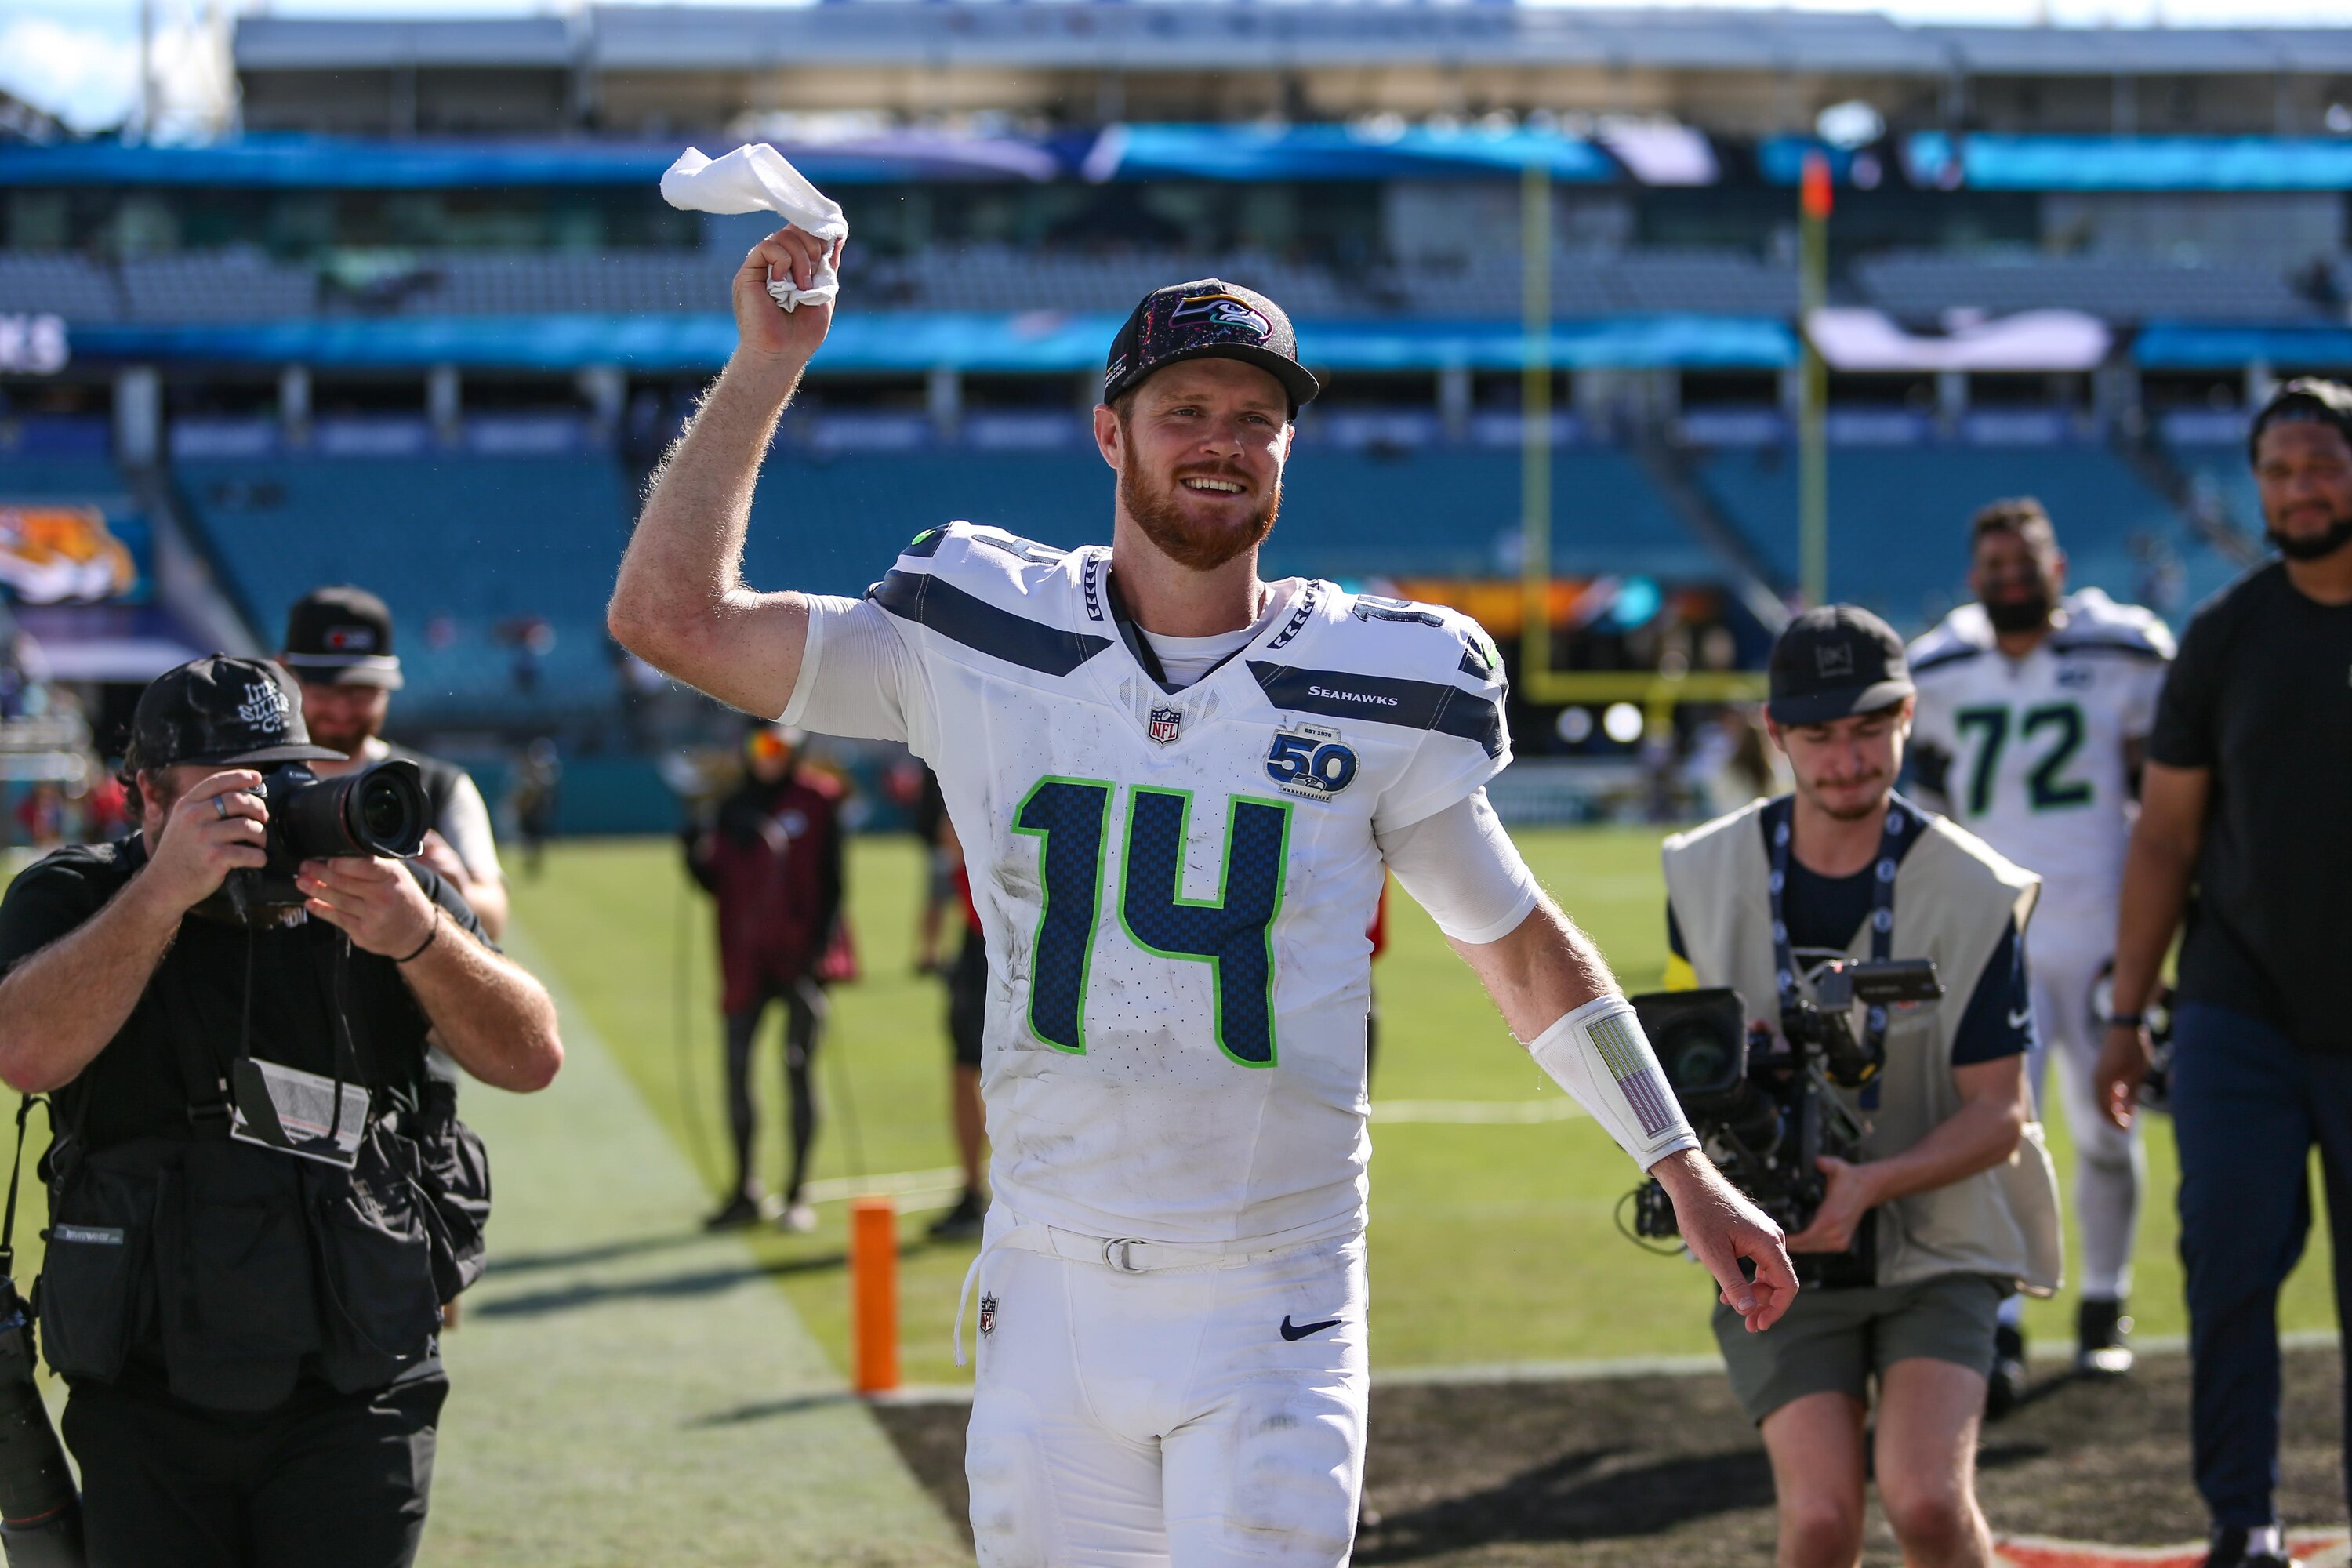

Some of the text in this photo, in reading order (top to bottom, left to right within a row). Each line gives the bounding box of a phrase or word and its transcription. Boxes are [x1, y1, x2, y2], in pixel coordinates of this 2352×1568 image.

[1308, 685, 1398, 706] SEAHAWKS
[1152, 721, 1176, 740] NFL
[1267, 733, 1357, 792] 50
[1955, 705, 2092, 816] 72
[1010, 774, 1295, 1069] 14
